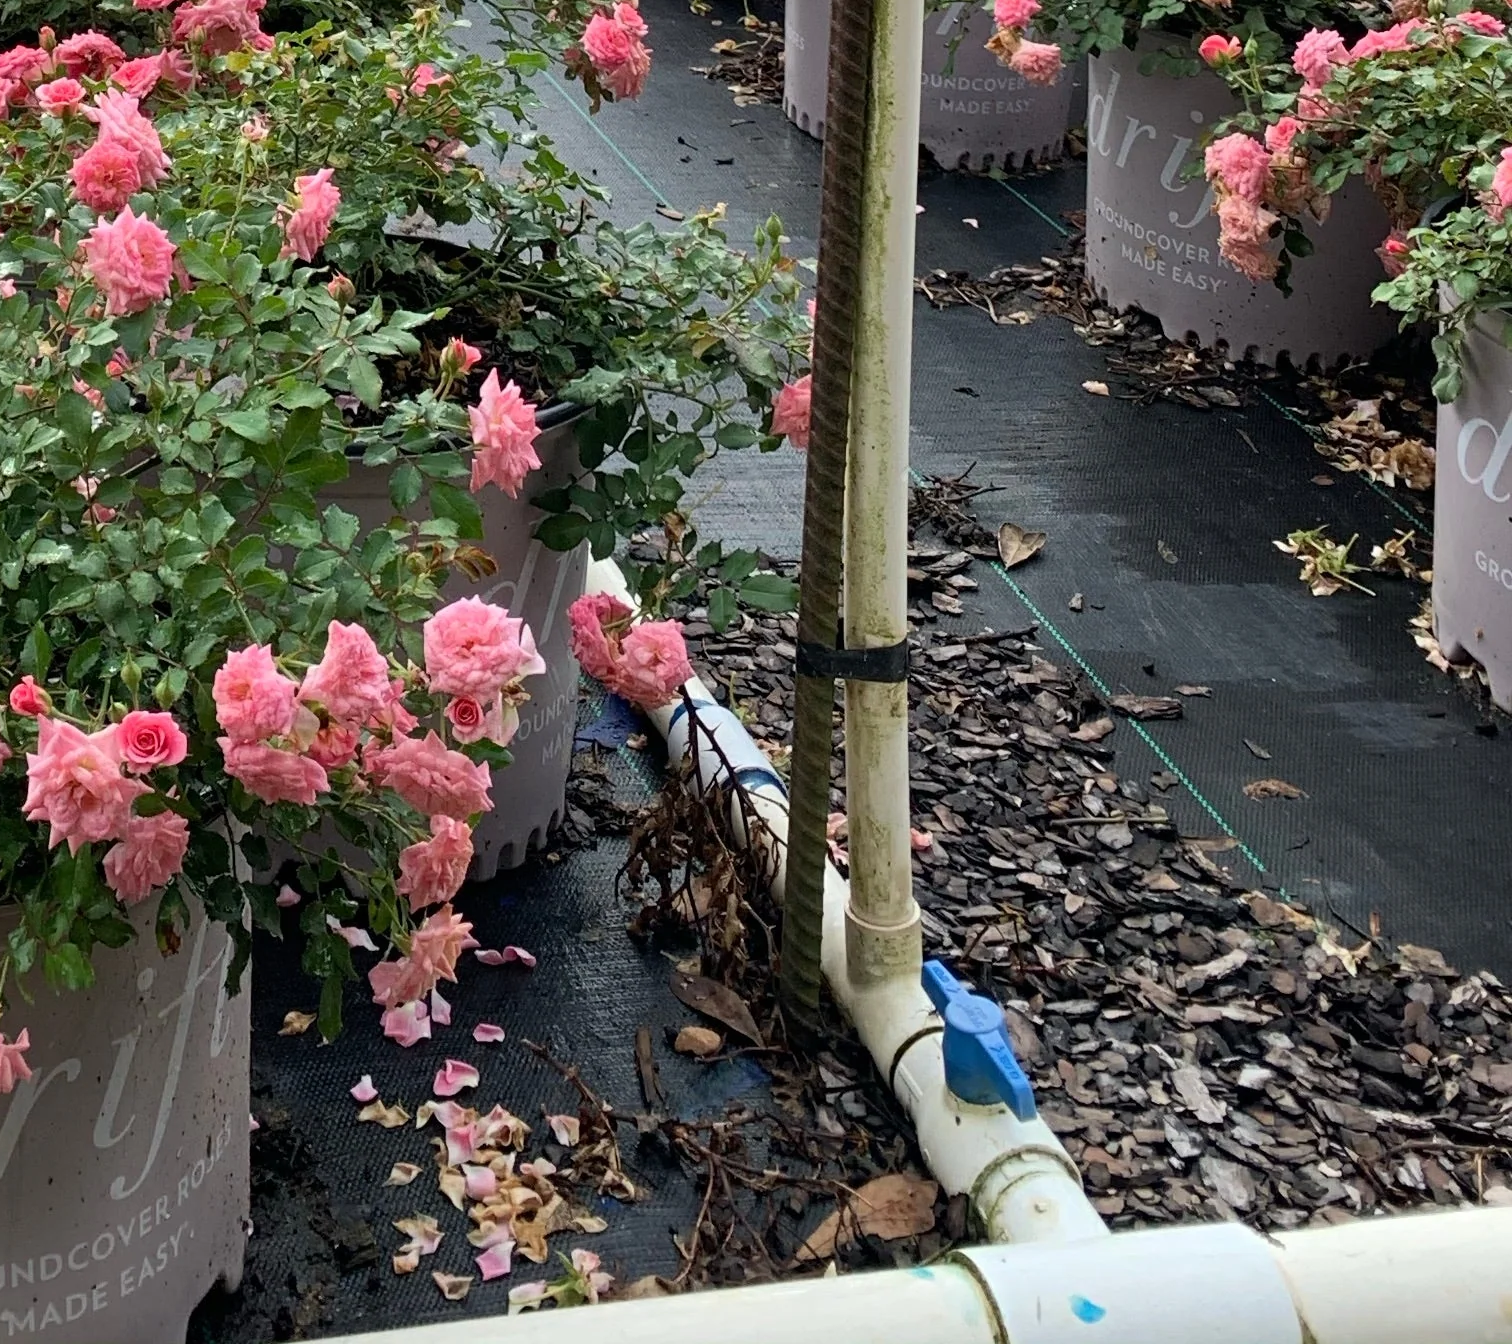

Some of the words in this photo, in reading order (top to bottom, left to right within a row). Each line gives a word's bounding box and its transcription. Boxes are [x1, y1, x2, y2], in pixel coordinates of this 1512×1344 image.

[921, 73, 1026, 92] OUNDCOVER
[940, 97, 989, 114] MADE
[1093, 197, 1210, 264] GROUNDCOVER
[1121, 244, 1167, 276] MADE
[1172, 265, 1223, 294] EASY
[177, 1111, 232, 1207] ROSES
[3, 1280, 110, 1337] MADE
[120, 1220, 188, 1298] EASY
